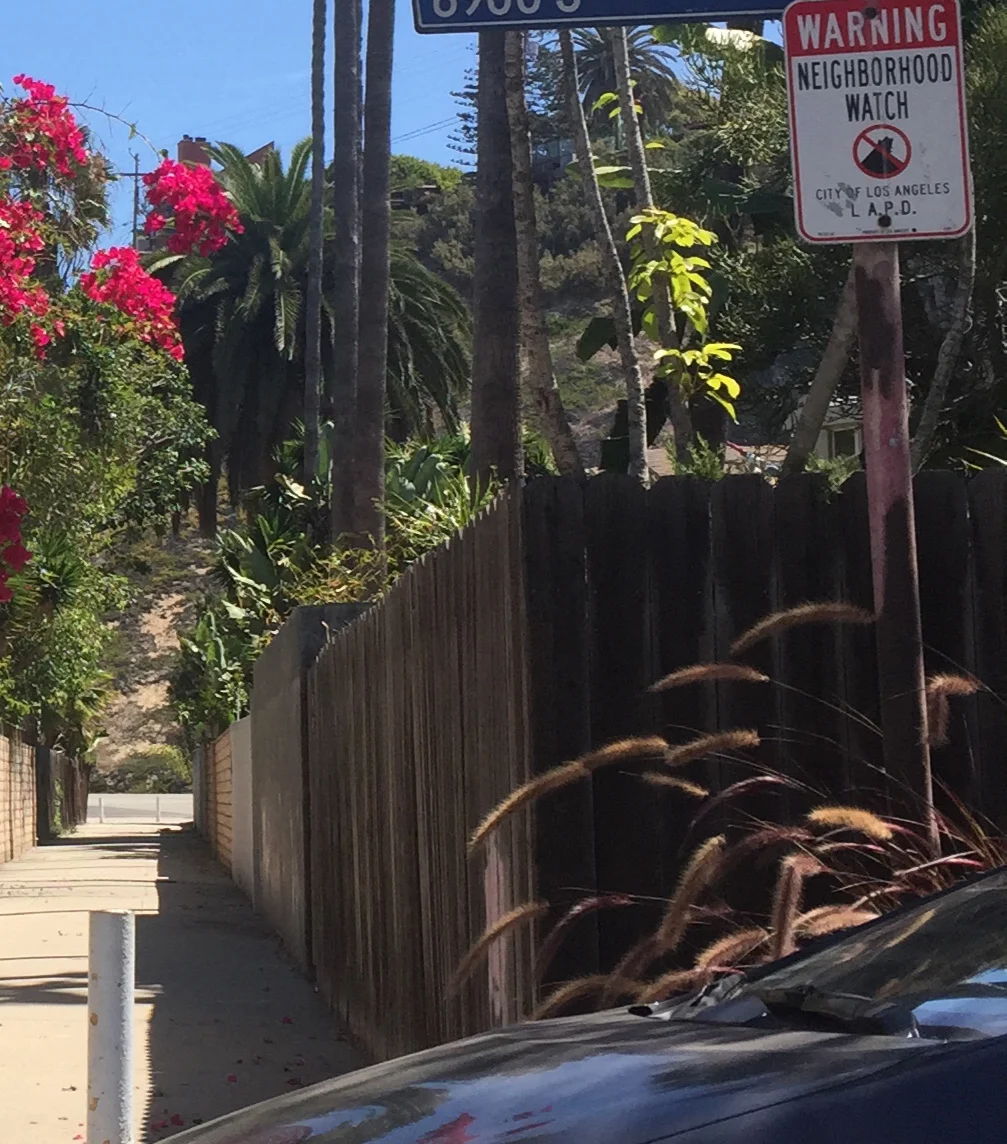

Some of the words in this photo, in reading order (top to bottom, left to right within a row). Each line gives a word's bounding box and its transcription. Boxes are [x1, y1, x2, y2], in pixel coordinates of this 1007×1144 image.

[797, 4, 947, 51] WARNING
[797, 53, 953, 91] NEIGHBORHOOD
[845, 91, 909, 122] WATCH
[815, 188, 841, 201] CITY
[846, 186, 862, 199] OF
[866, 185, 891, 198] LOS
[894, 182, 951, 196] ANGELES
